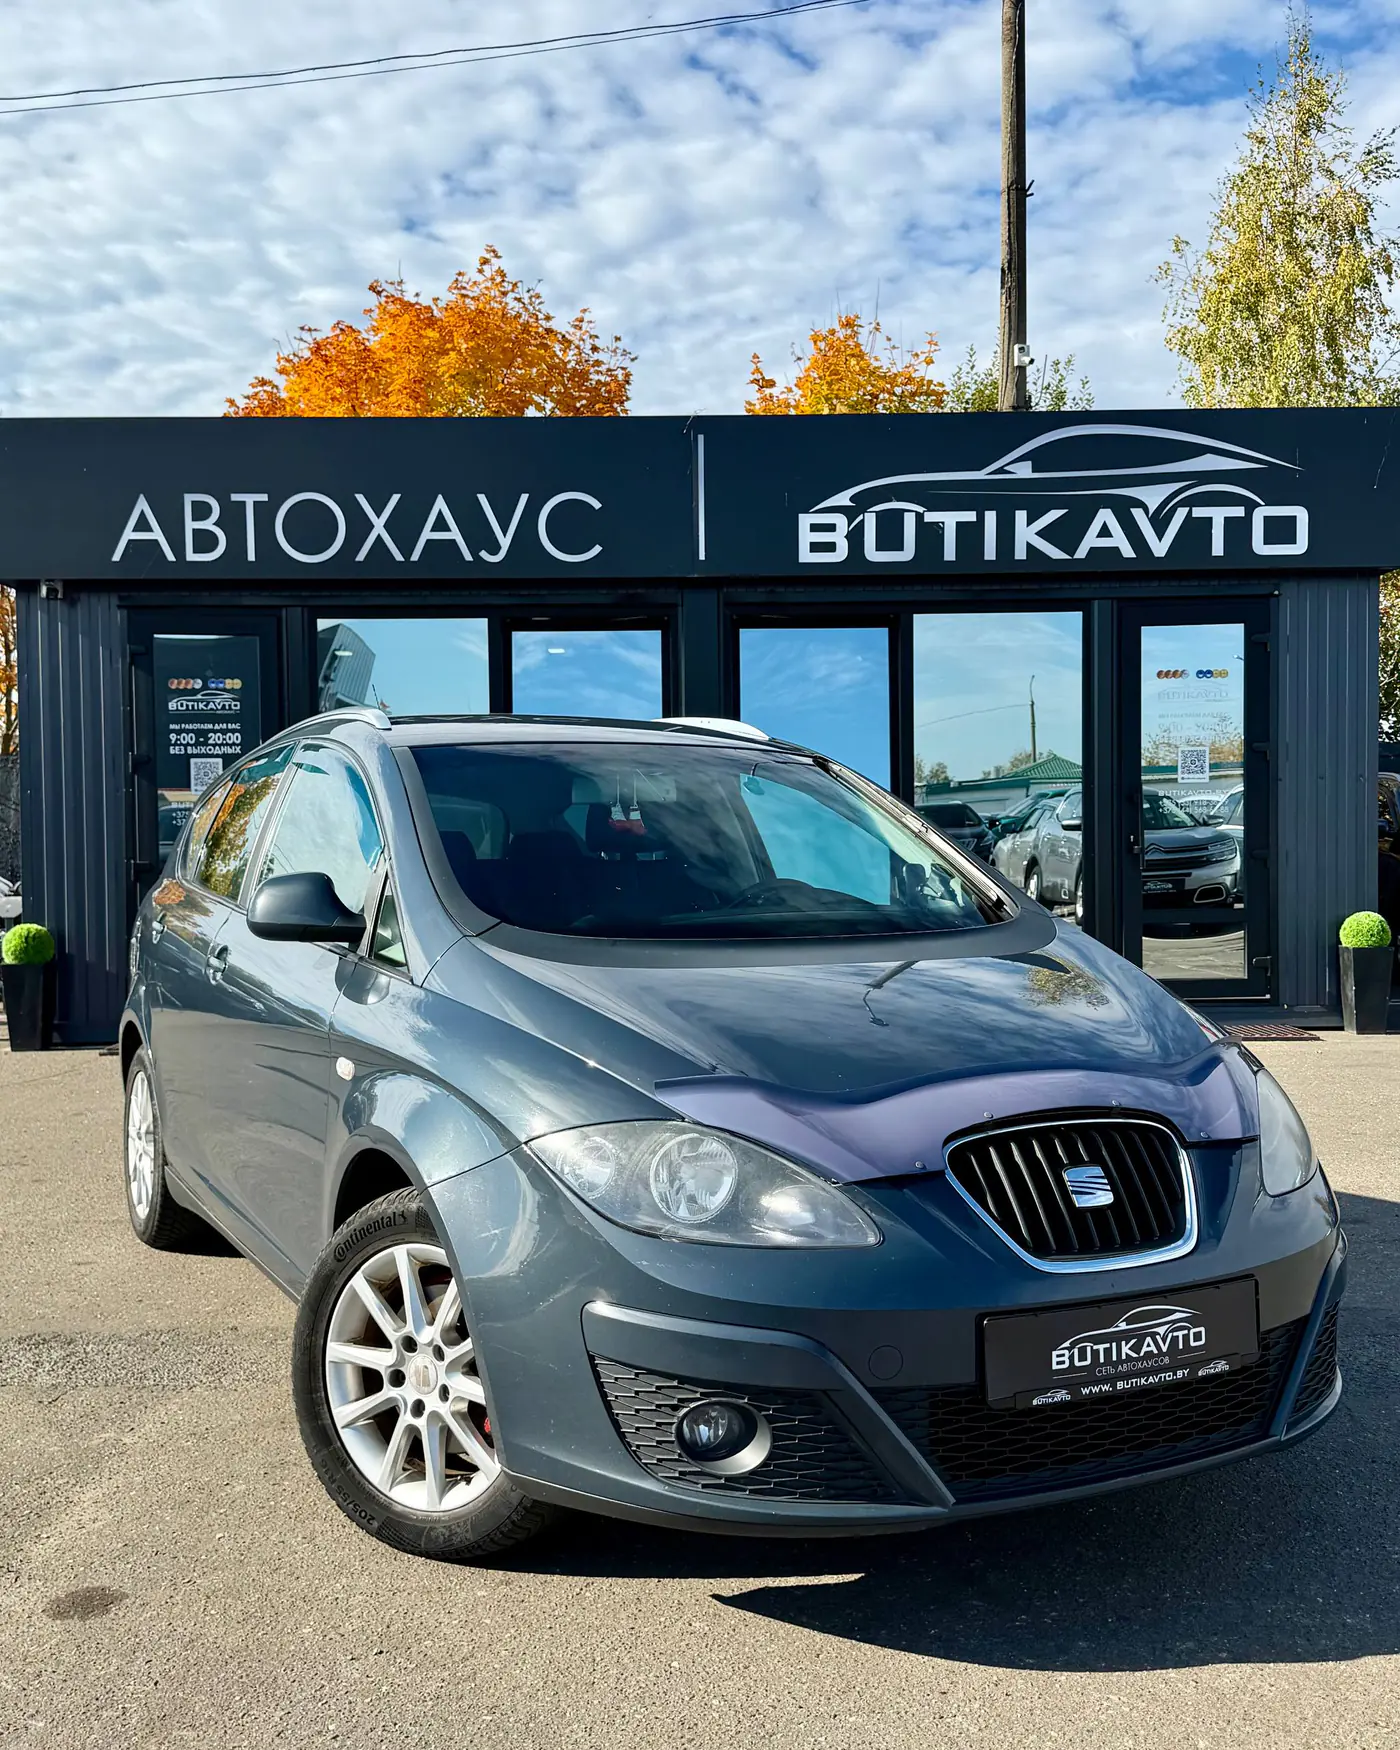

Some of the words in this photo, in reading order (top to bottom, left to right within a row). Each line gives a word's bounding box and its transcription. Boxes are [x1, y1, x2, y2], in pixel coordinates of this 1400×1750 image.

[111, 491, 603, 564] АВТОХАУС
[798, 504, 1309, 564] BUTIKAVTO
[168, 701, 241, 710] BUTIKAVTO
[169, 732, 196, 744] 9:00
[207, 732, 242, 744] 20:00
[169, 745, 185, 754] БЕЗ
[186, 745, 242, 755] ВЫХОДНЫХ
[334, 1211, 397, 1263] Continental
[1051, 1326, 1206, 1370] BUTIKAVTO
[1095, 1366, 1116, 1376] СЕТЬ
[1117, 1356, 1170, 1373] АВТОХАУСОВ
[1197, 1365, 1230, 1377] BUTIKAVTO
[1080, 1383, 1113, 1396] WWW.
[1116, 1368, 1190, 1391] BUTIKAVTO.BY
[1032, 1395, 1071, 1406] BUTIKAVTO
